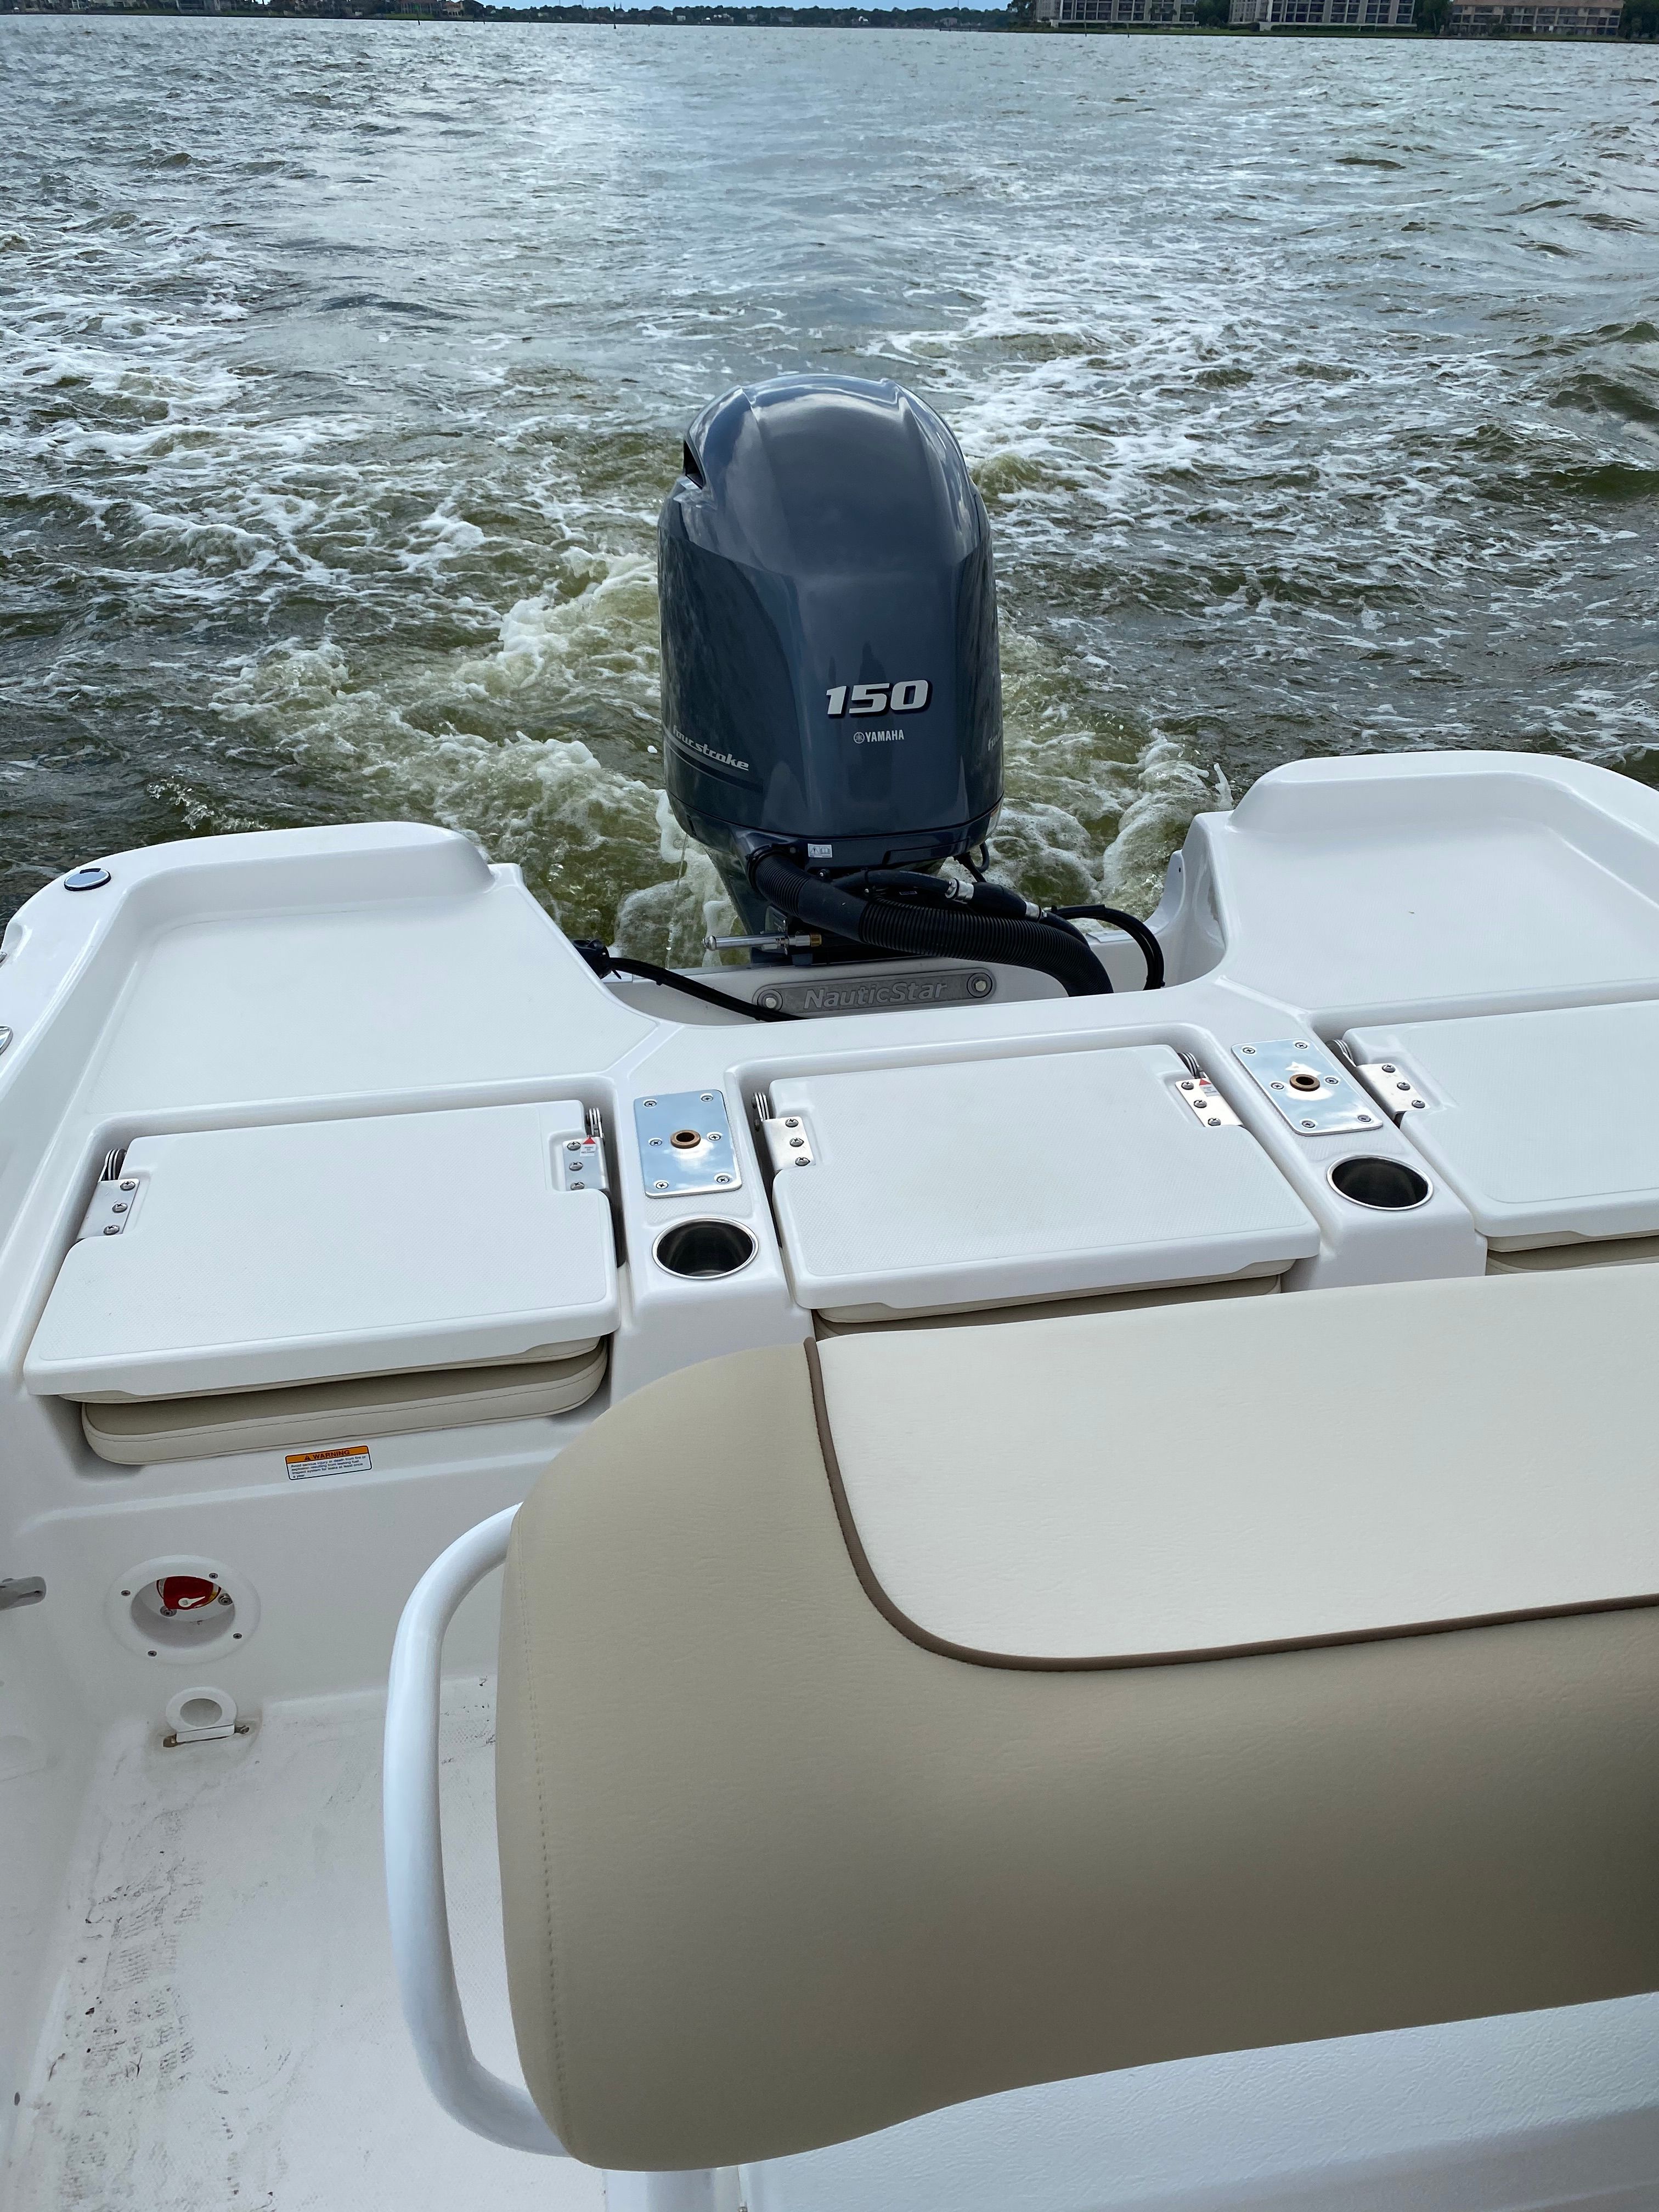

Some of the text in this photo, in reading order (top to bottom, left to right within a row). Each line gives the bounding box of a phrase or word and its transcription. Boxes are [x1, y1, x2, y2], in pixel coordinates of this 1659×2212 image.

[826, 679, 930, 715] 150
[865, 729, 905, 742] YAMAHA
[803, 981, 947, 1010] NauticStar
[312, 1450, 350, 1459] WARNING
